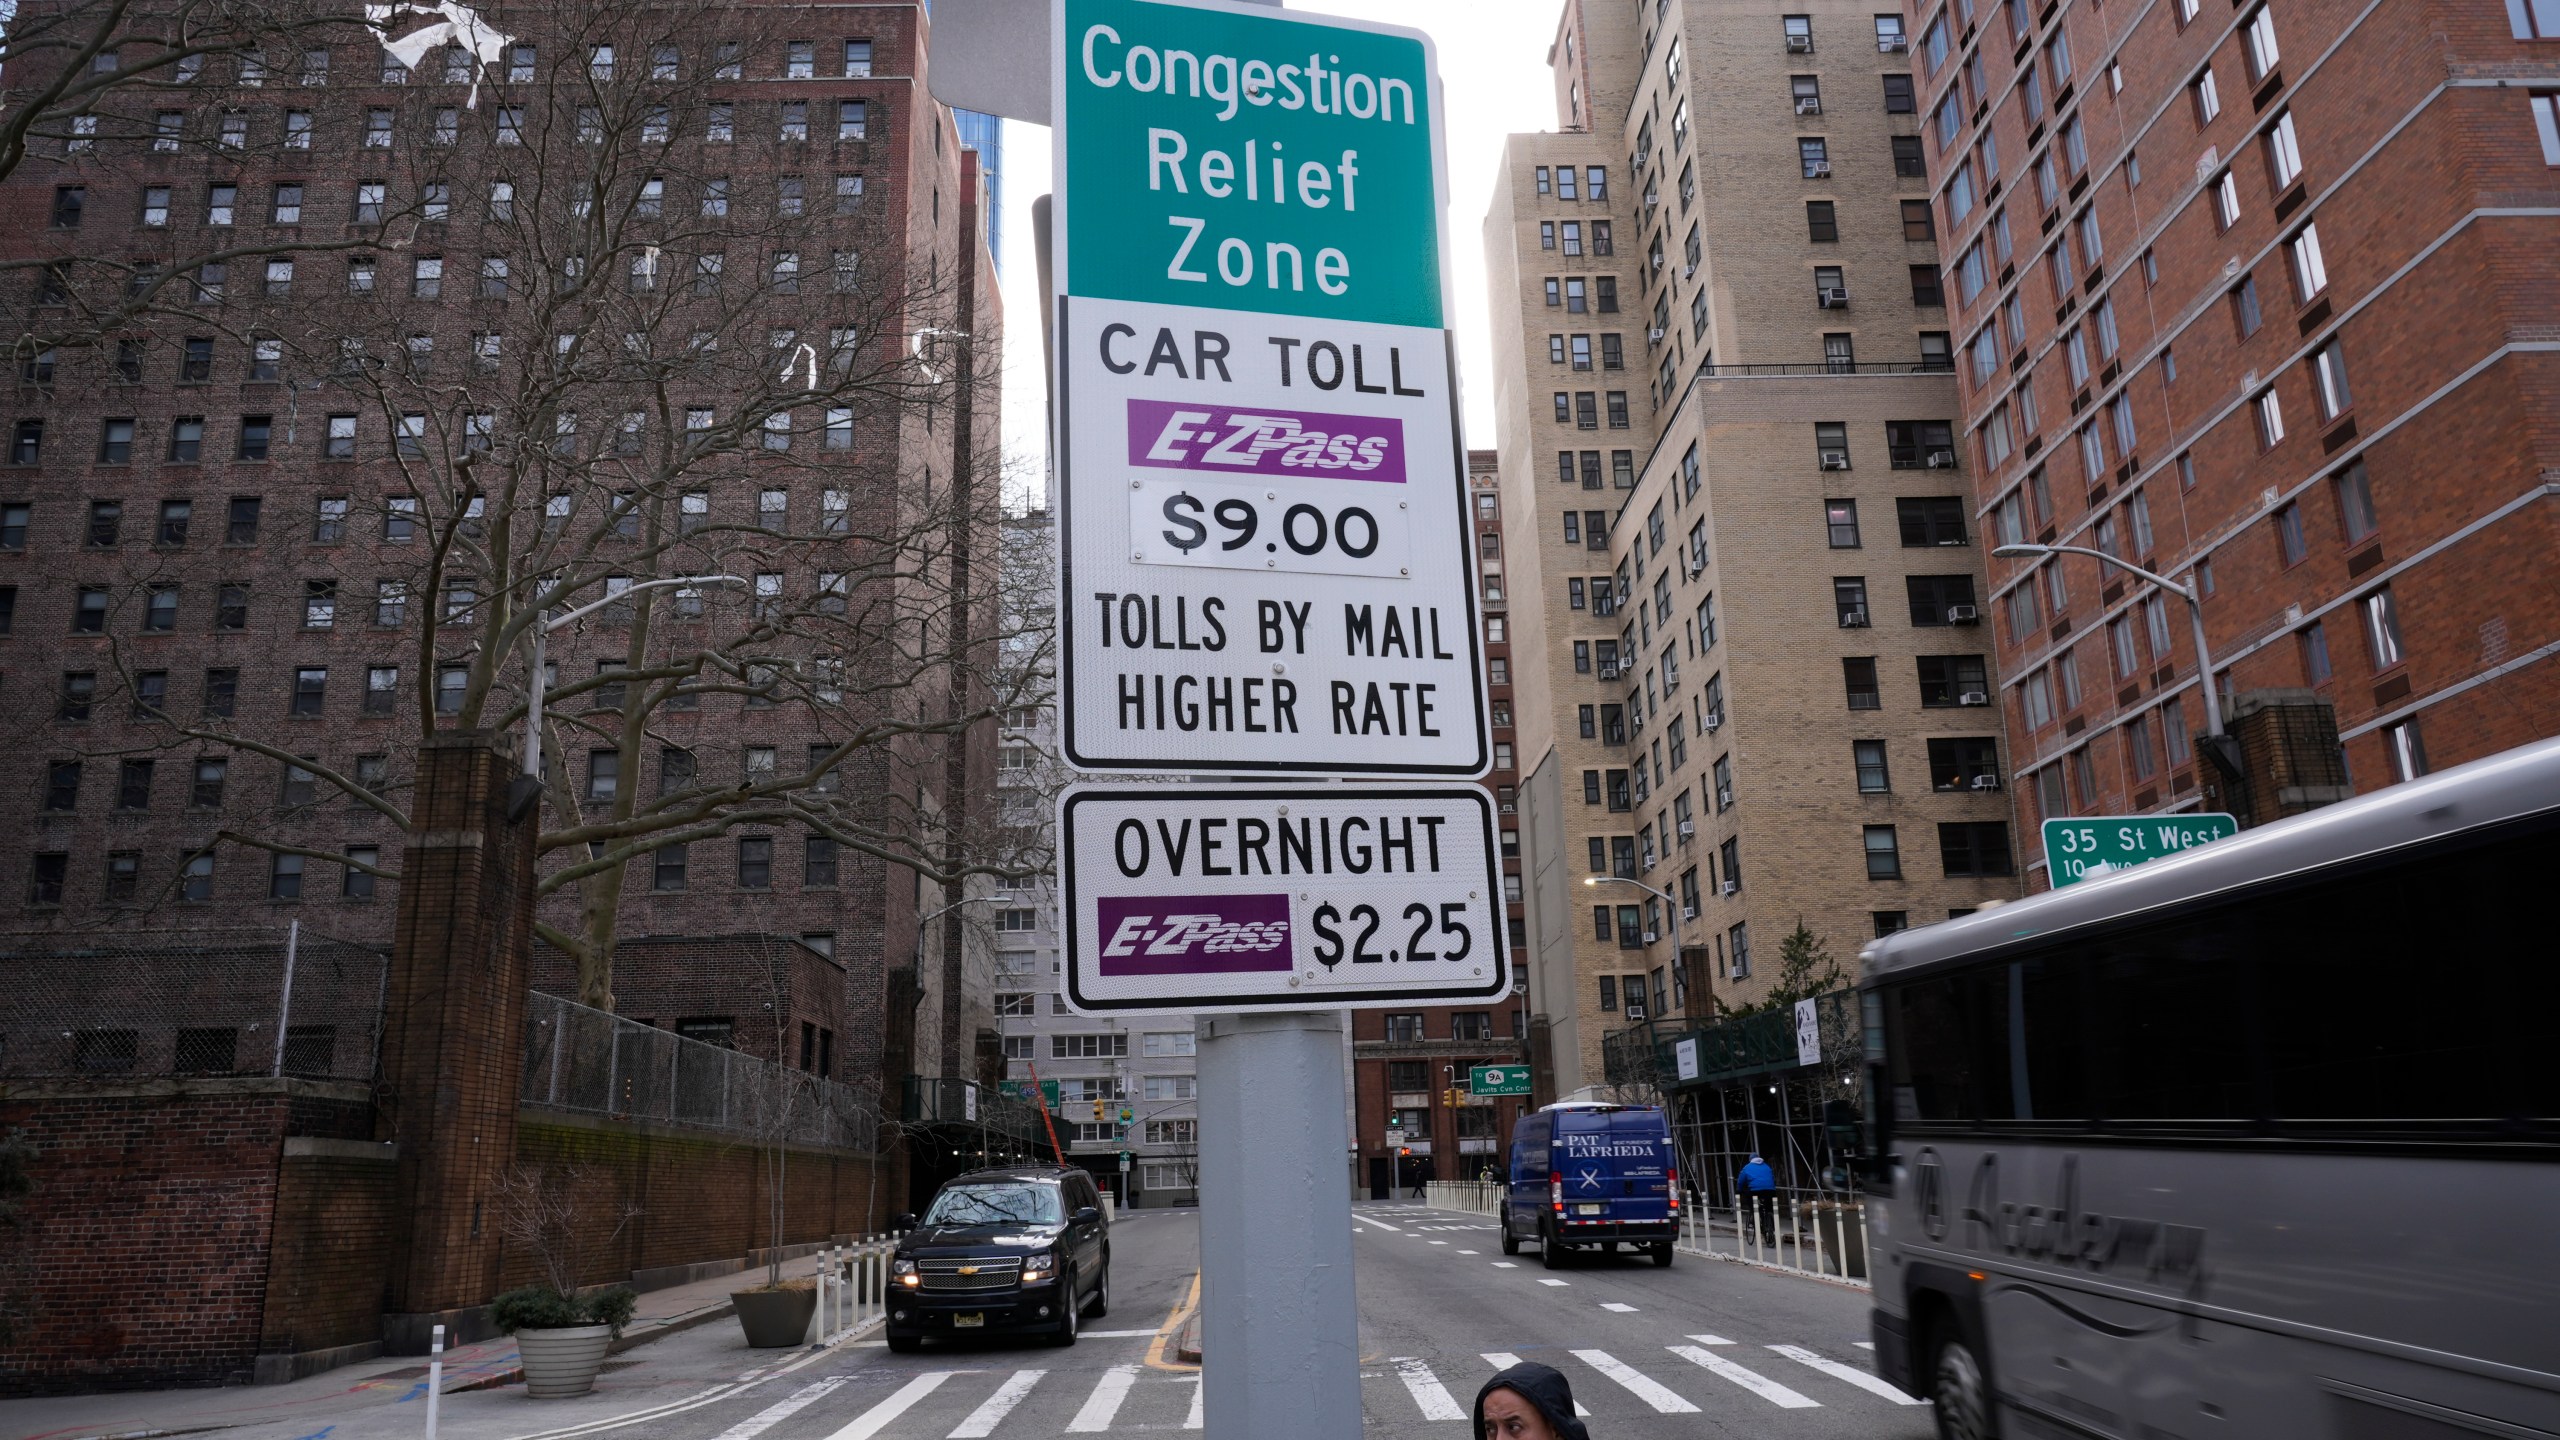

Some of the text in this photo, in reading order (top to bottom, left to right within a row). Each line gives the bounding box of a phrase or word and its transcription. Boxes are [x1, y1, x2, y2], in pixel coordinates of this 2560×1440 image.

[1082, 24, 1415, 125] Congestion
[1148, 127, 1359, 211] Relief
[1167, 215, 1350, 296] Zone
[1100, 323, 1425, 398] CAR TOLL
[1162, 491, 1379, 559] $9.00
[1094, 593, 1454, 660] TOLLS BY MAIL
[1118, 674, 1441, 737] HIGHER RATE
[1115, 816, 1445, 878] OVERNIGHT
[2060, 826, 2220, 853] 35 St West
[2063, 858, 2086, 878] 10
[1312, 900, 1472, 973] $2.25
[1488, 1072, 1502, 1082] 9A
[1567, 1135, 1599, 1146] PAT
[1569, 1145, 1655, 1157] LAFRIEDA
